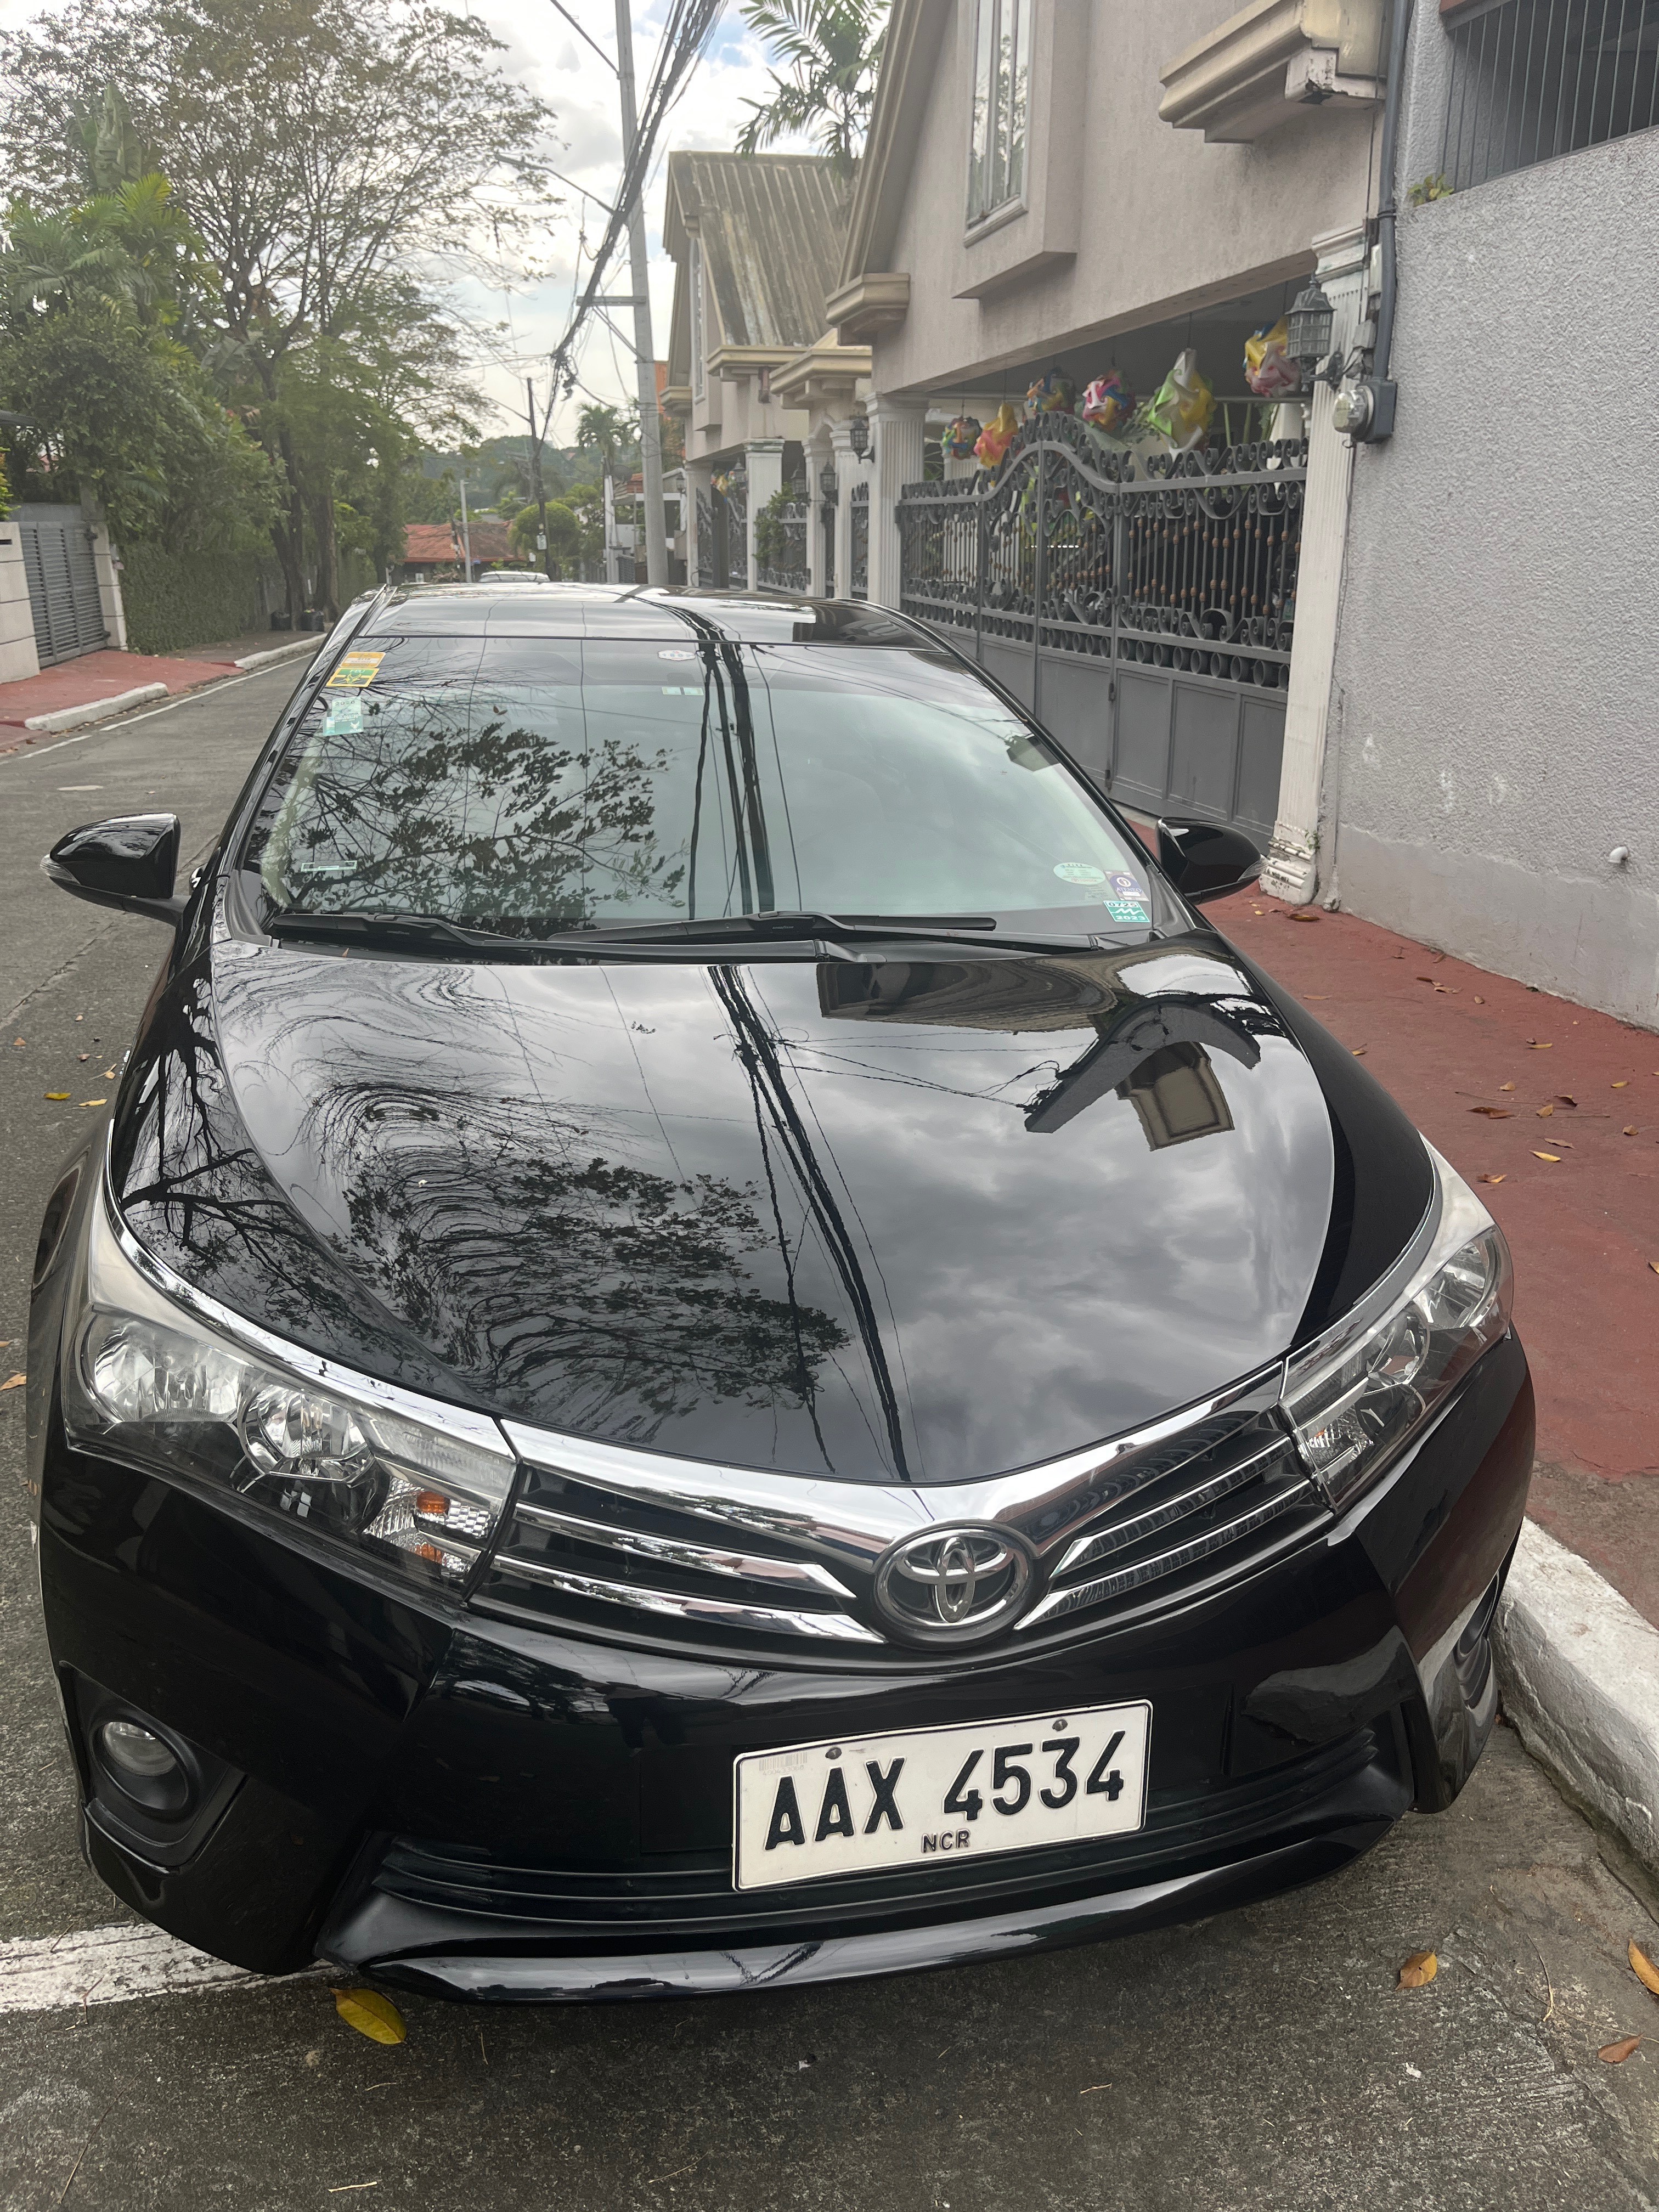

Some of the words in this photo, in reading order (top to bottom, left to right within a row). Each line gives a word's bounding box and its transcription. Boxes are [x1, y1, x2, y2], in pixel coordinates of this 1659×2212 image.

[764, 1756, 905, 1850] AAX
[943, 1730, 1126, 1820] 4534
[922, 1830, 970, 1853] NCR
